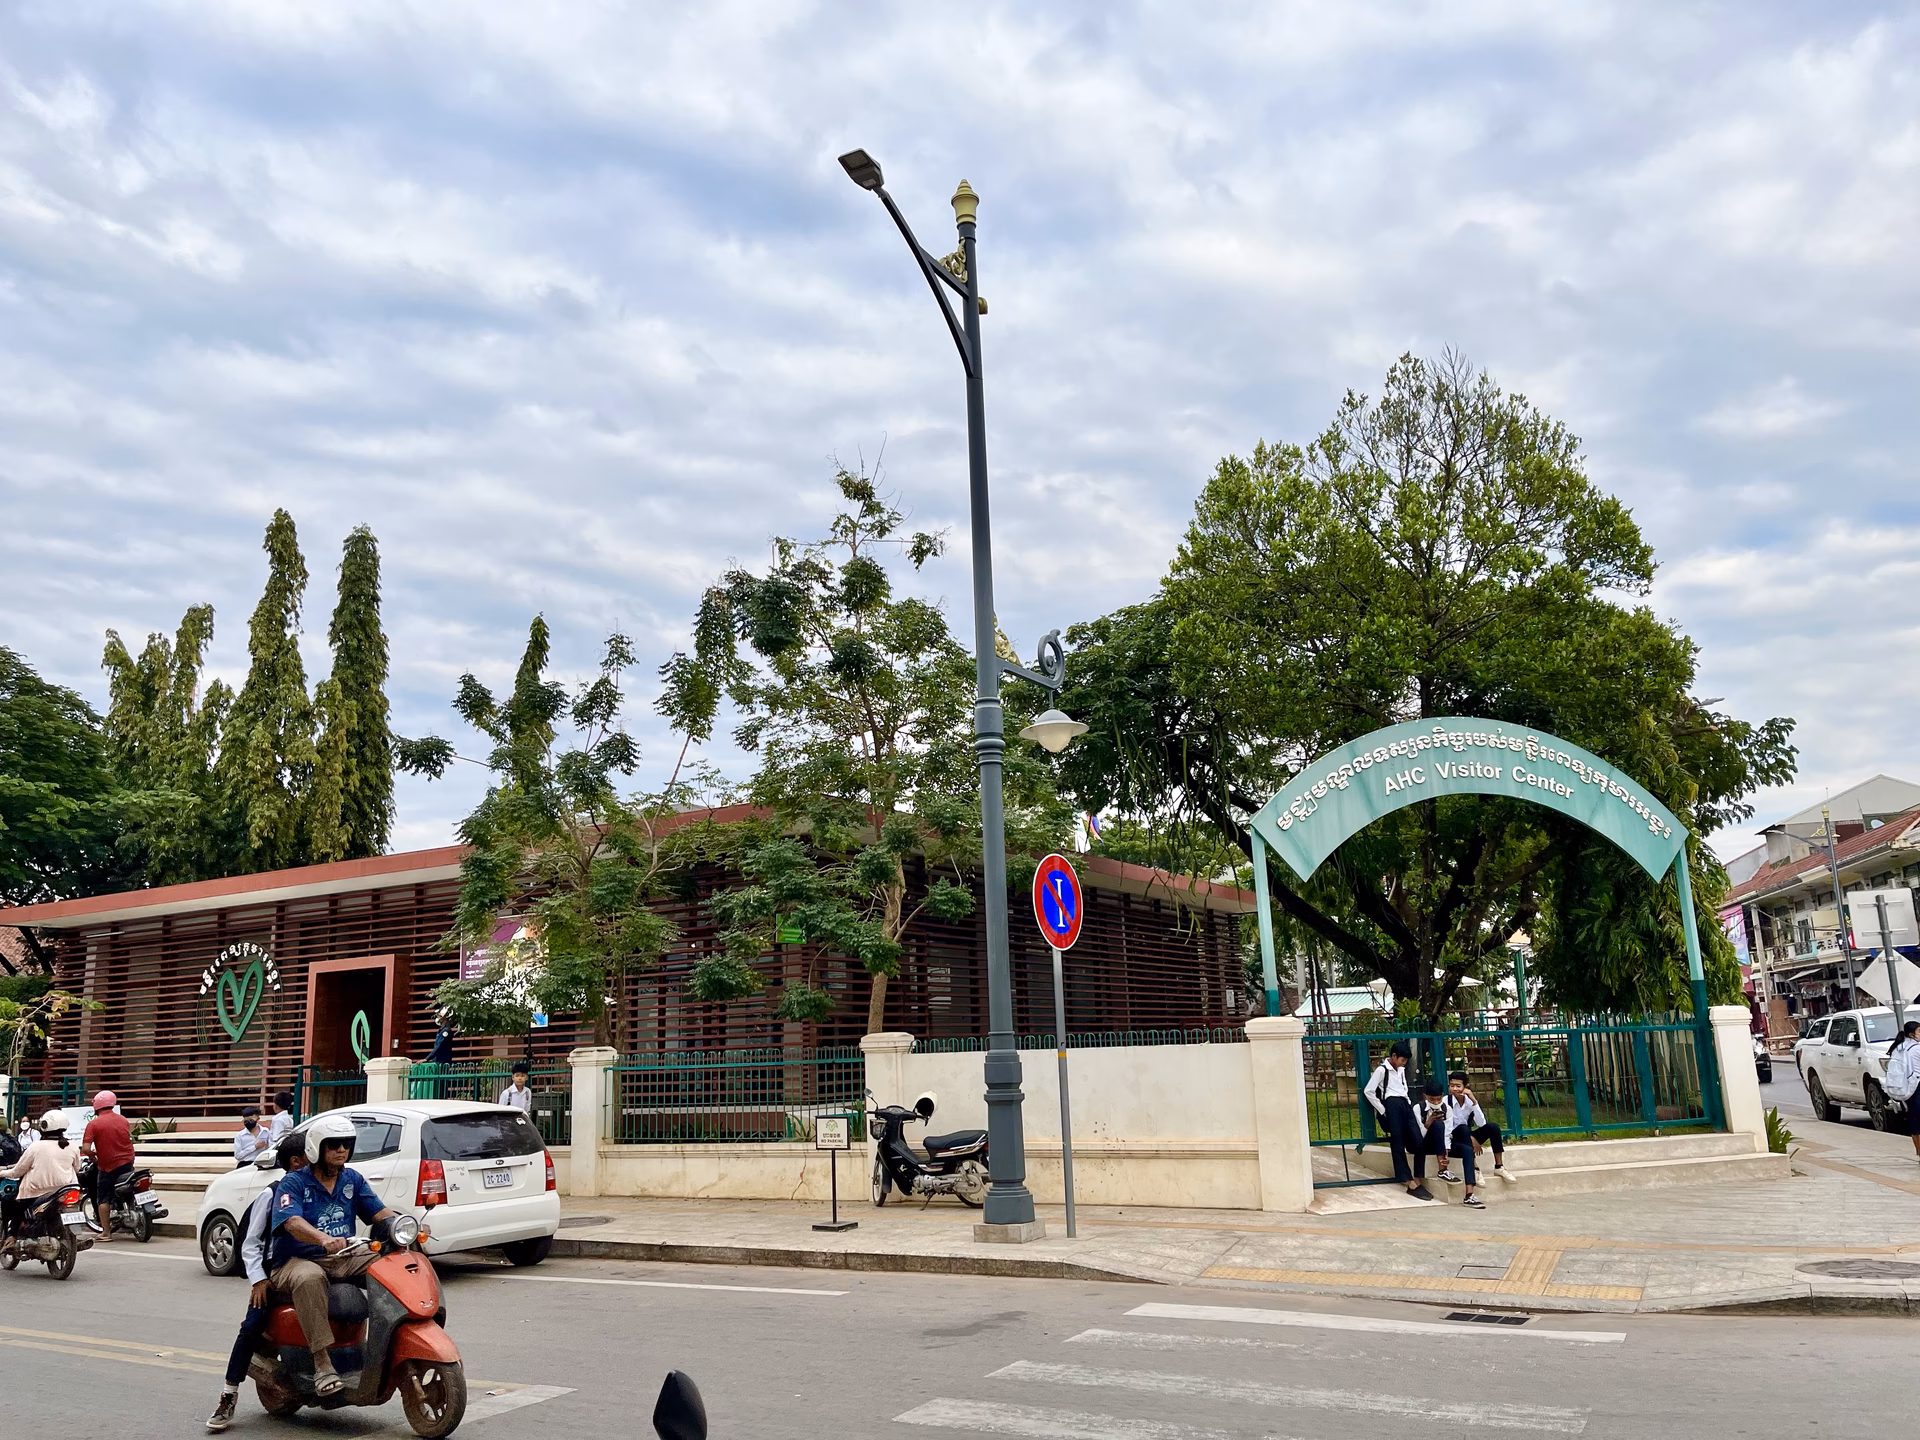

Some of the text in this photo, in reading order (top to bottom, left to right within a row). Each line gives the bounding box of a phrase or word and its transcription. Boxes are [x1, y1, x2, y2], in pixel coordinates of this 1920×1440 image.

[1385, 759, 1574, 799] AHC Visitor Center
[487, 1173, 510, 1185] 2C-2240
